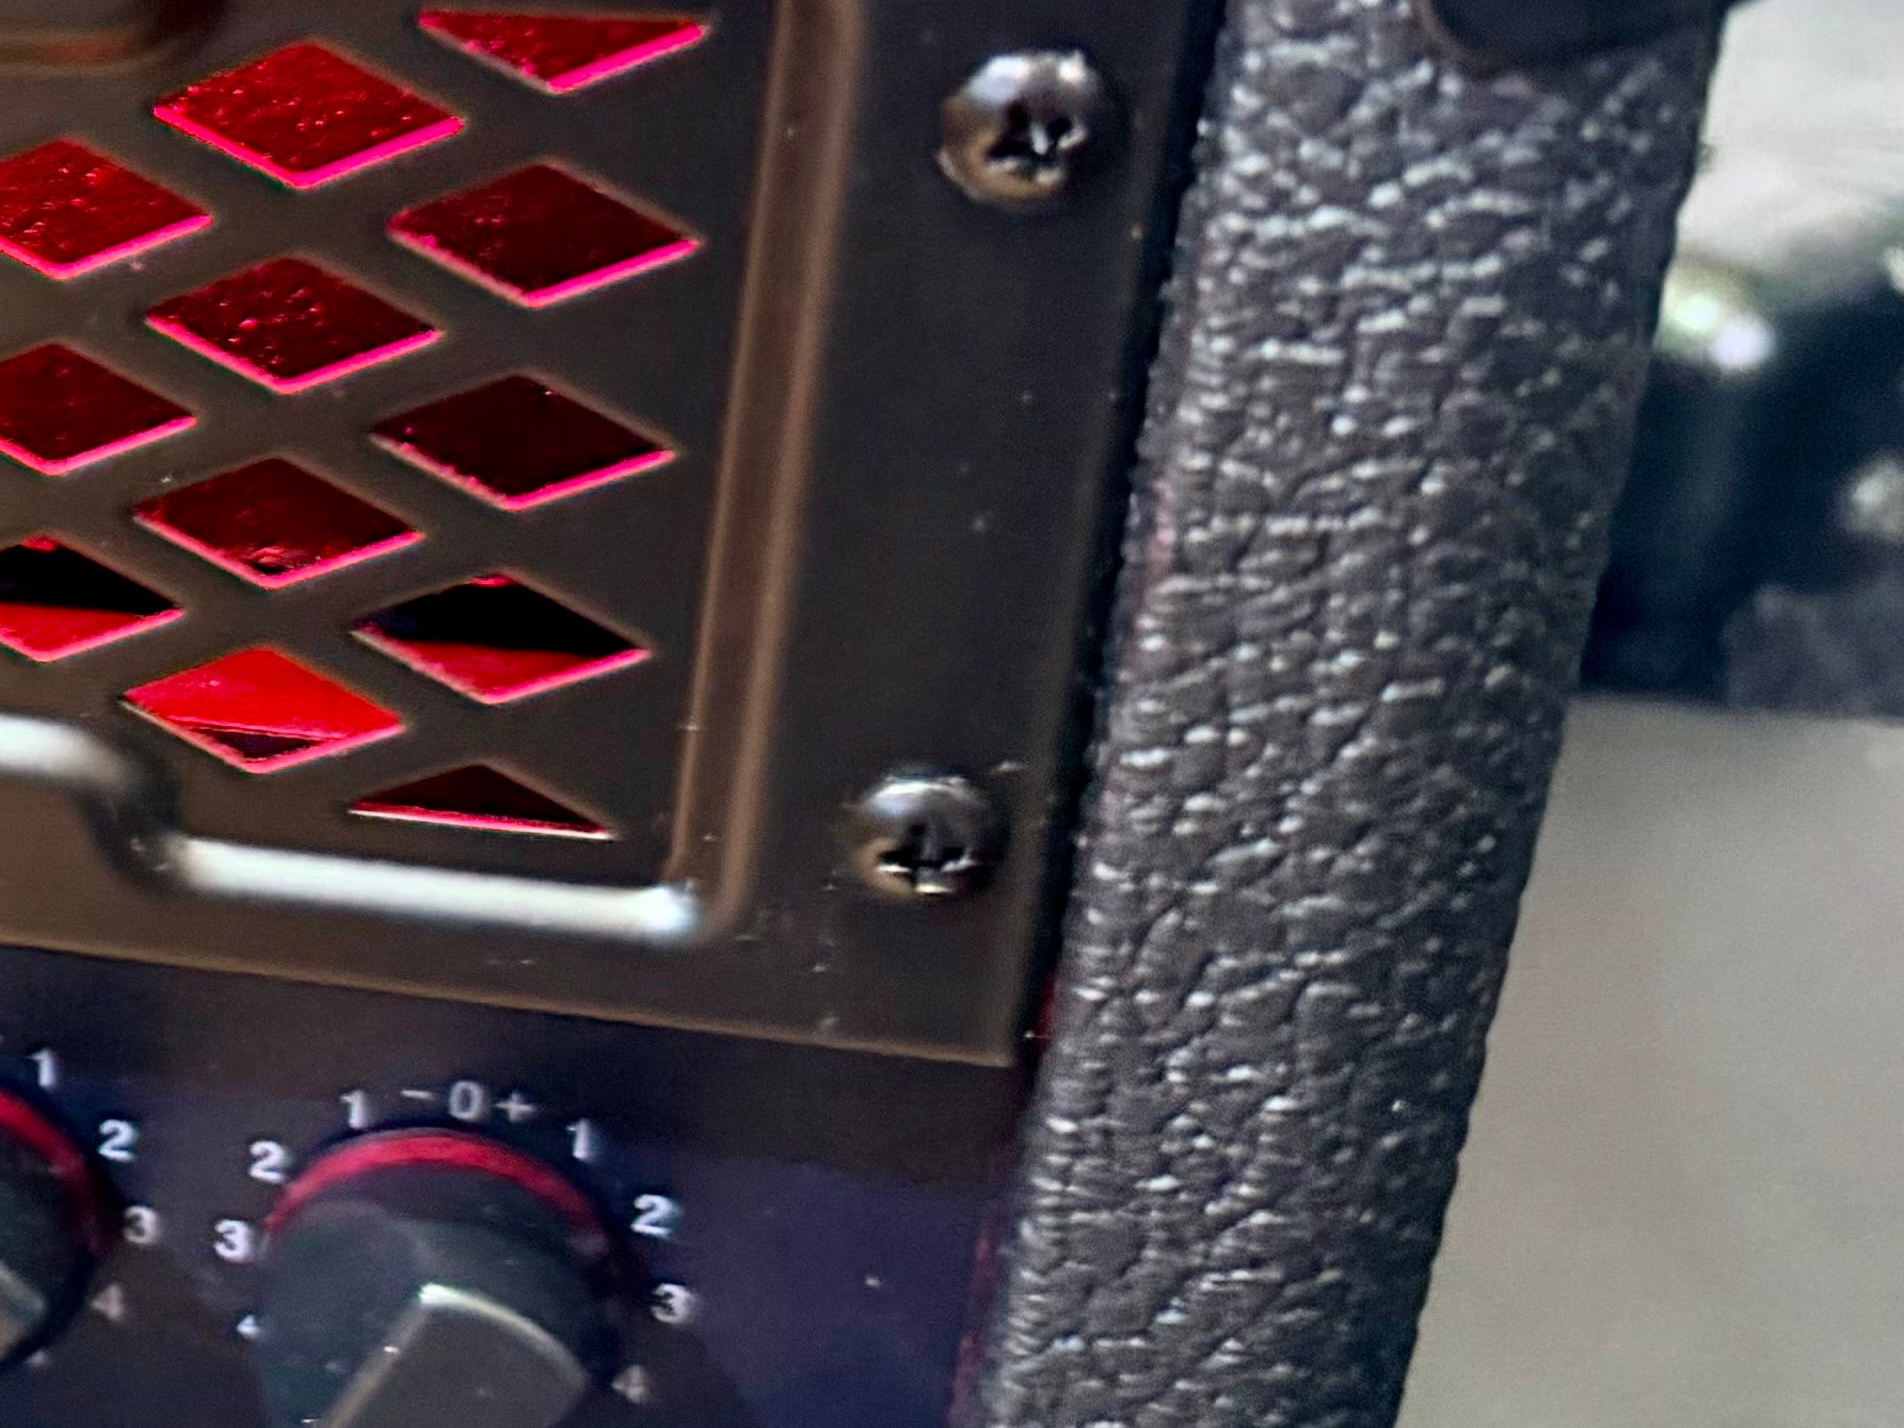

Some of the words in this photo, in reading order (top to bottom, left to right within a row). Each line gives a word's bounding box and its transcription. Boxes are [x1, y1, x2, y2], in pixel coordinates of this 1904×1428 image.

[339, 1090, 368, 1129] 1
[31, 1049, 57, 1088] 1
[98, 1119, 139, 1163] 2
[122, 1206, 160, 1245] 3
[567, 1118, 597, 1160] 1
[249, 1140, 290, 1184] 2
[632, 1193, 677, 1239] 2
[213, 1218, 254, 1262] 3
[650, 1282, 698, 1324] 3
